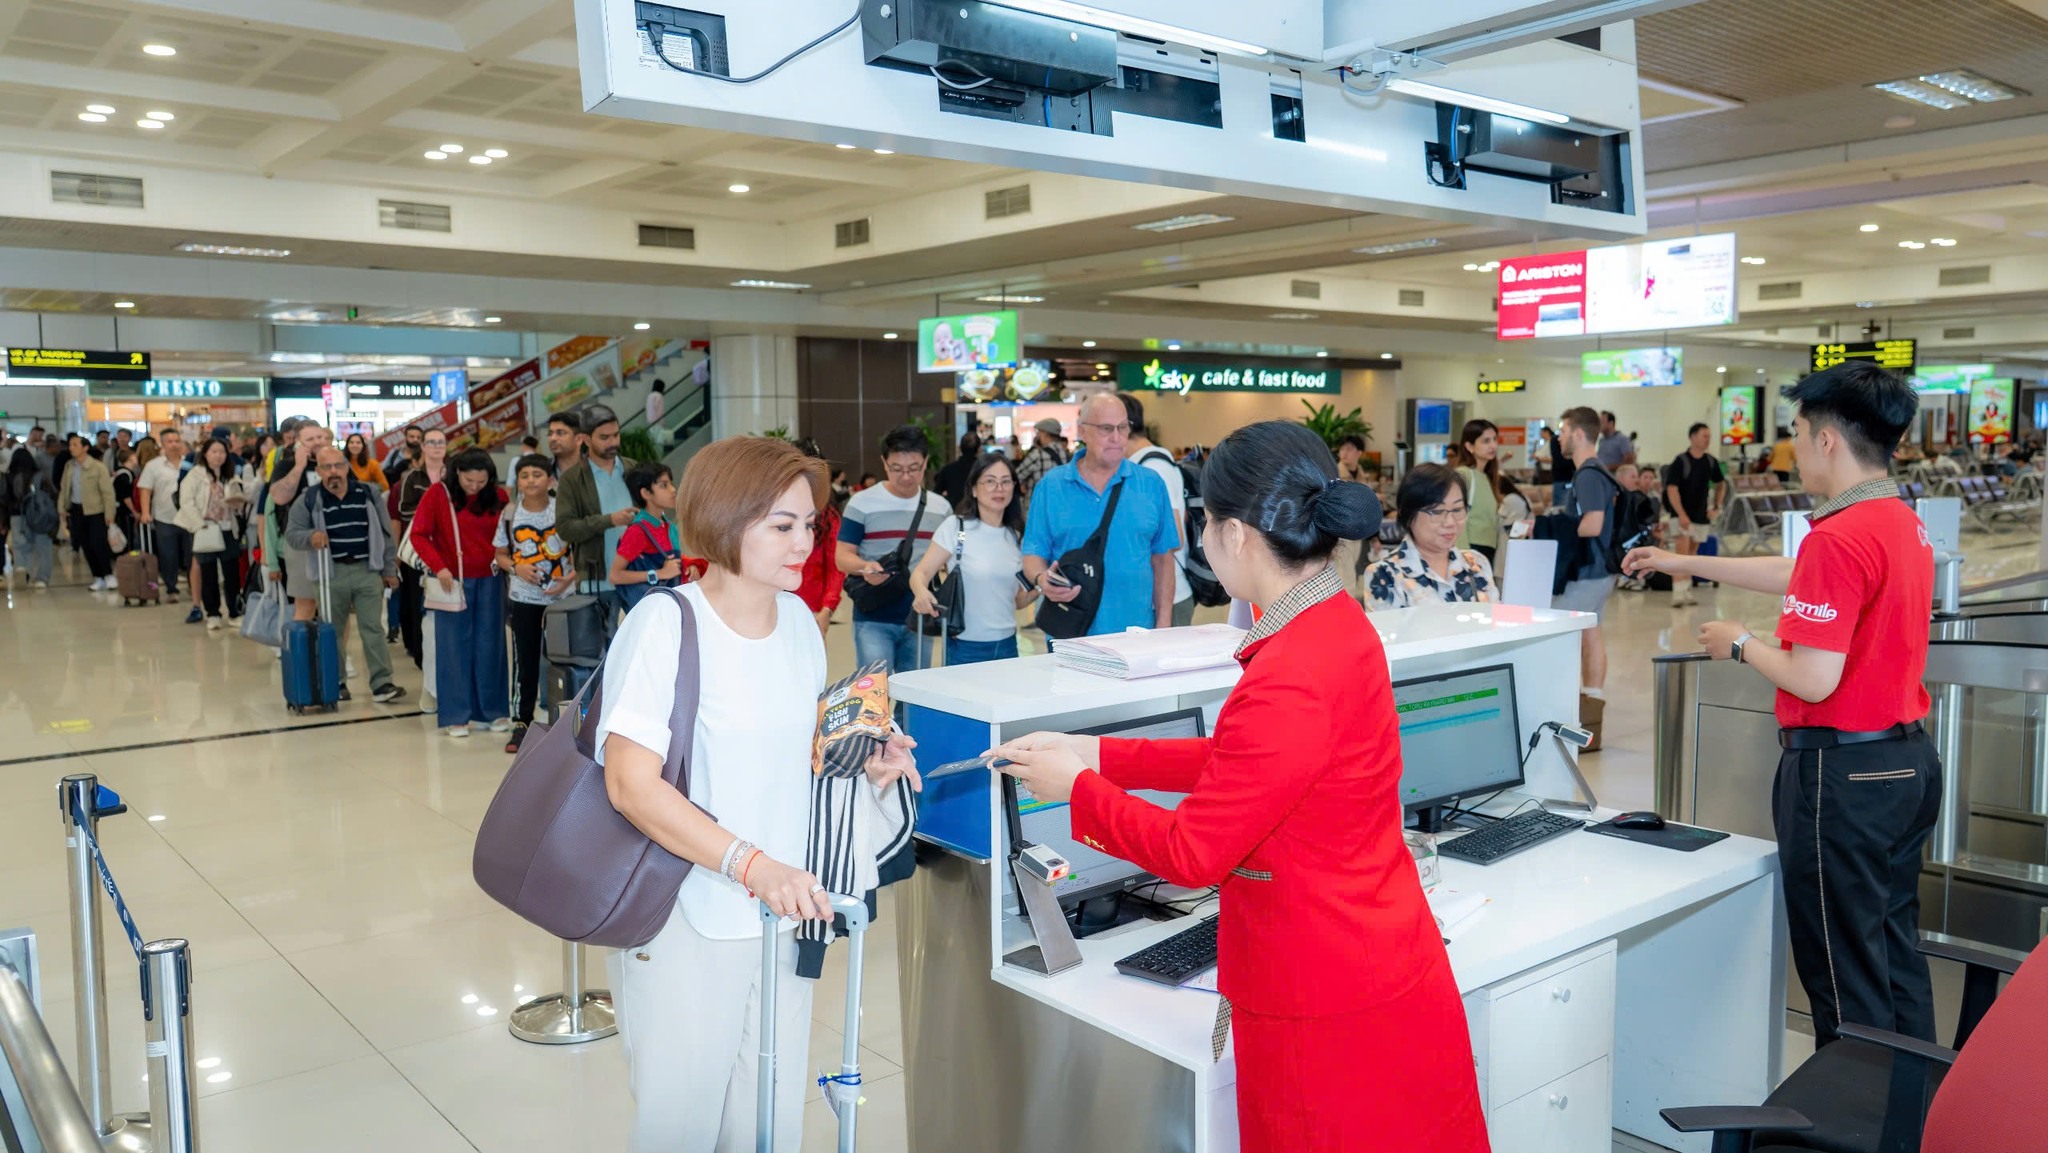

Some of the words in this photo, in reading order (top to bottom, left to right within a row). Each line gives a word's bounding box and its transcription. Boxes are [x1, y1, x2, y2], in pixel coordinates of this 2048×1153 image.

[1517, 263, 1583, 282] ARISTON
[144, 380, 221, 397] PRESTO
[1160, 370, 1195, 396] sky
[1202, 369, 1239, 386] cafe
[1242, 369, 1254, 386] &
[1258, 370, 1288, 387] fast
[1291, 370, 1326, 388] food
[828, 707, 849, 722] FISH
[828, 715, 850, 731] SKIN
